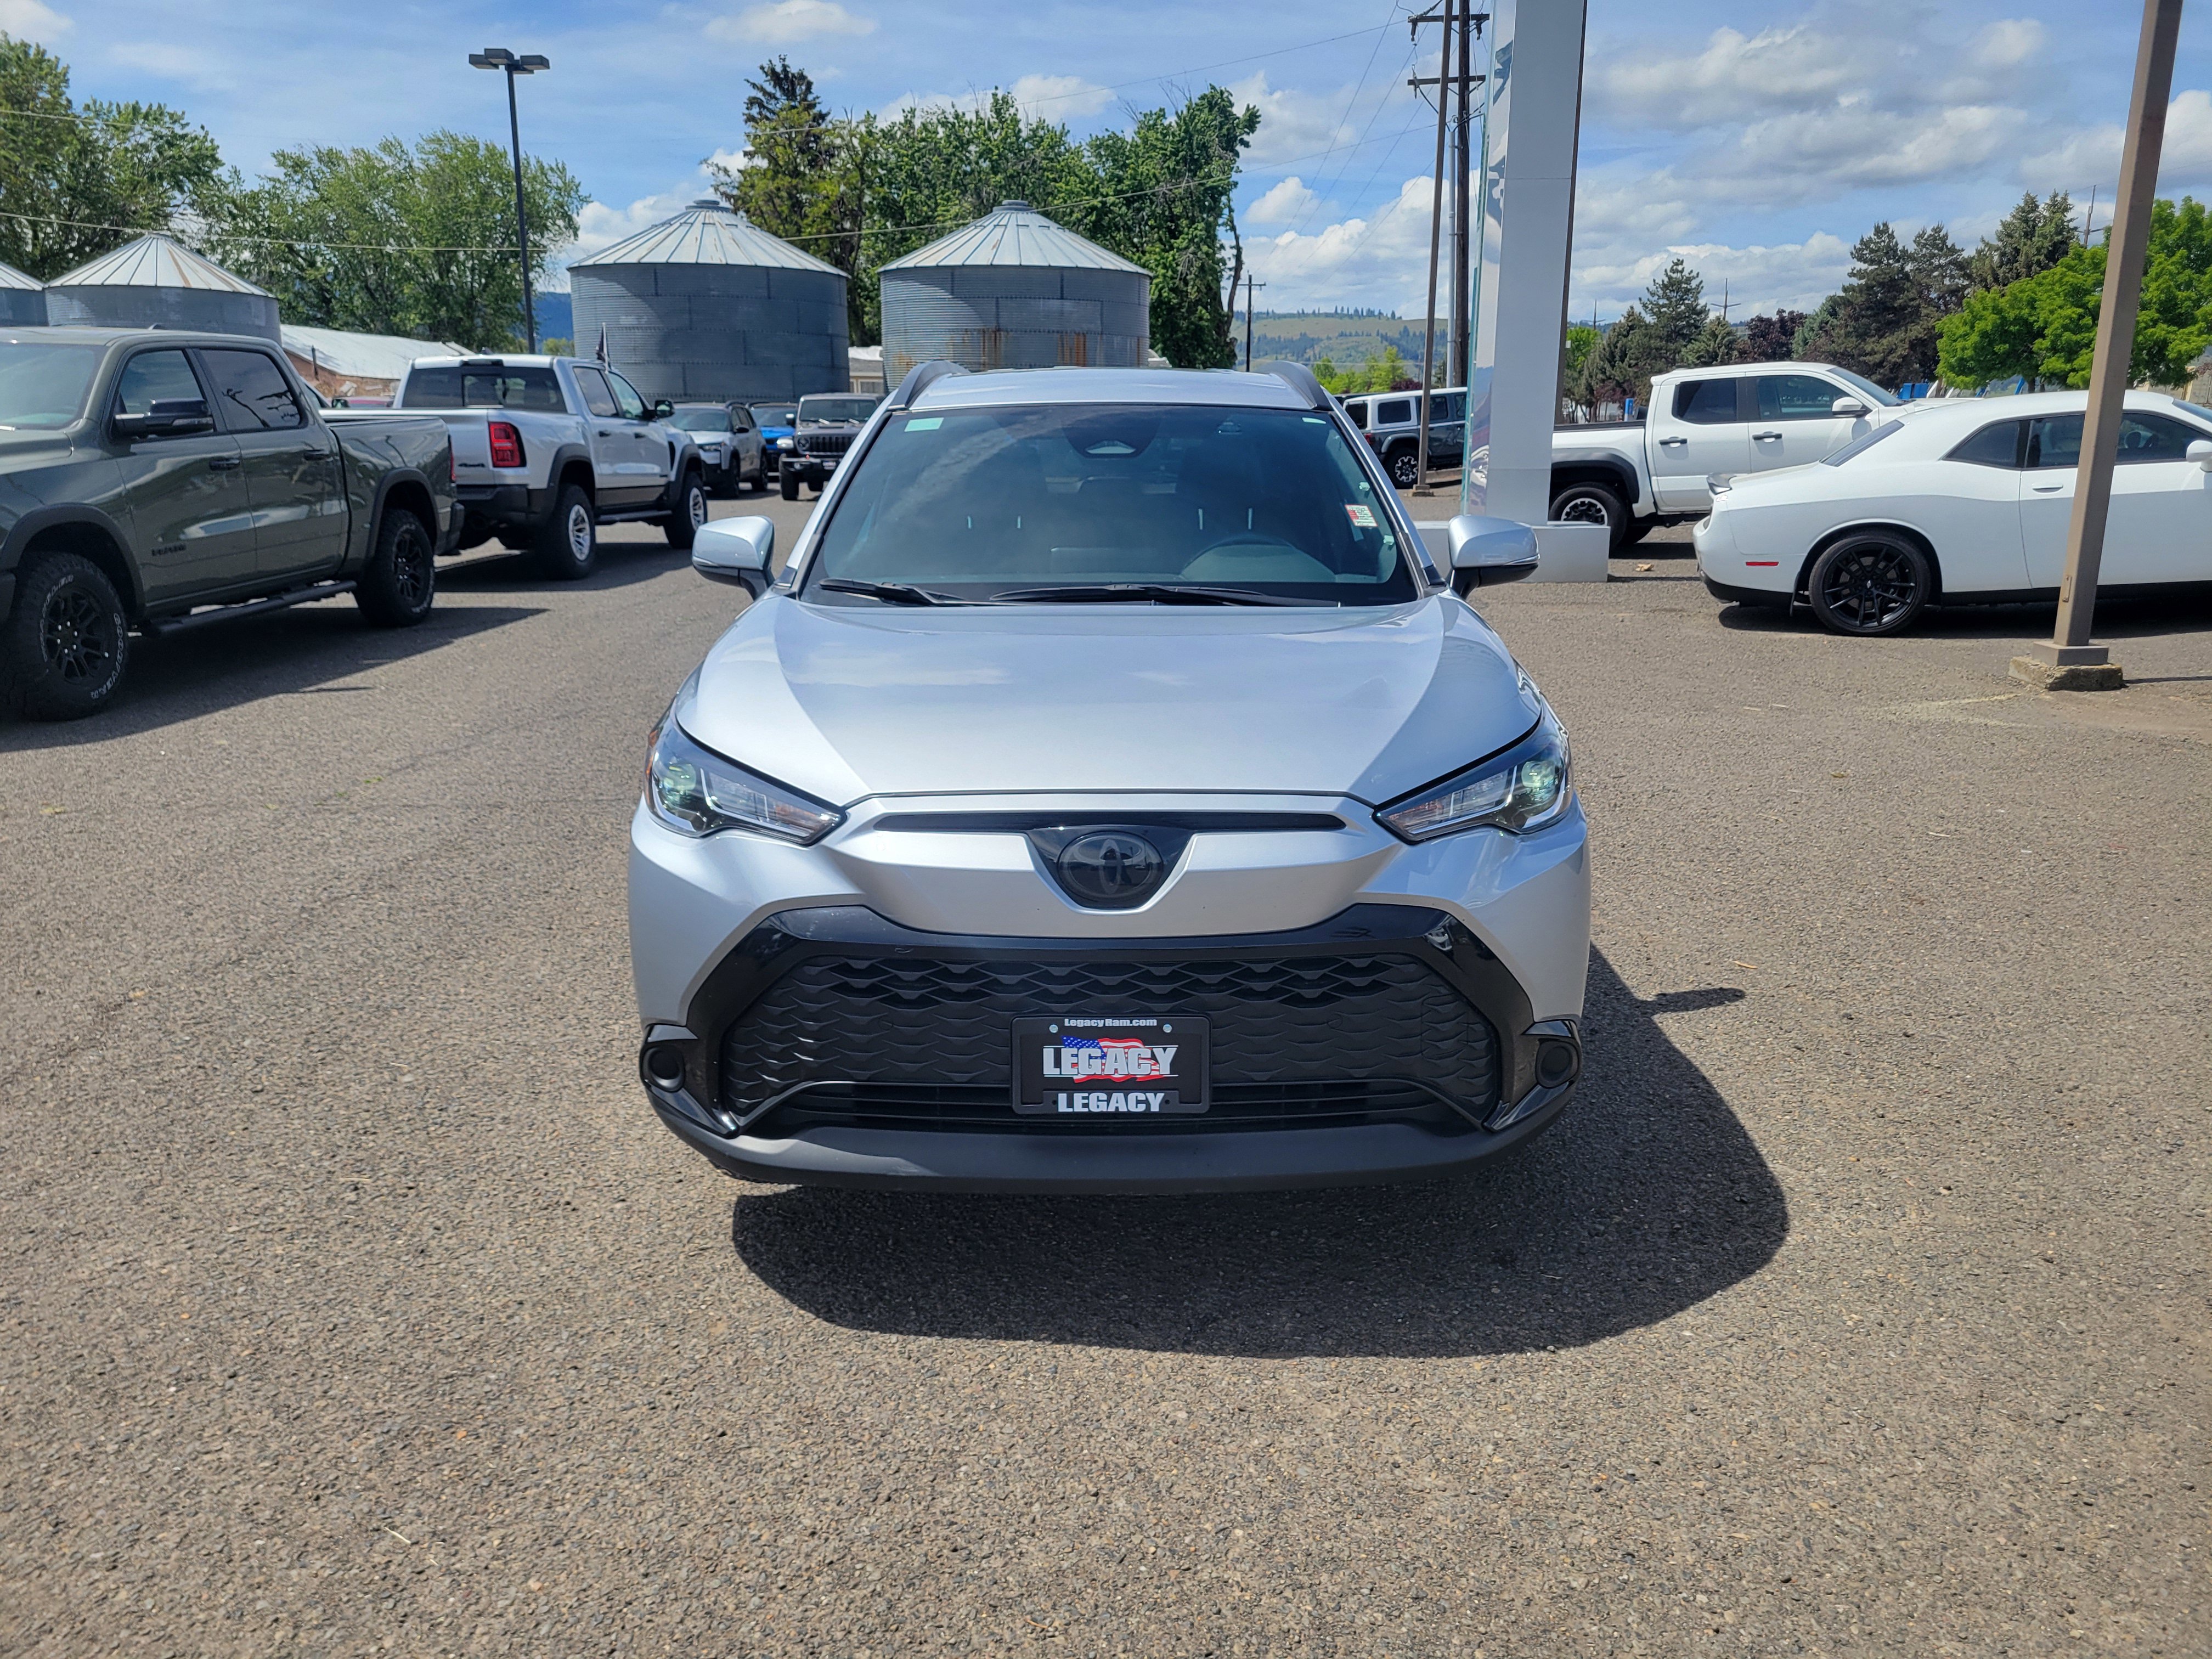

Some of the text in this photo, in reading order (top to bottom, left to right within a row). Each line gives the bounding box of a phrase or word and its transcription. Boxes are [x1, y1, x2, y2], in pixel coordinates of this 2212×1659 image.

[90, 612, 124, 699] GOODYEAR
[1042, 1047, 1177, 1075] LEGACY
[1057, 1092, 1165, 1112] LEGACY
